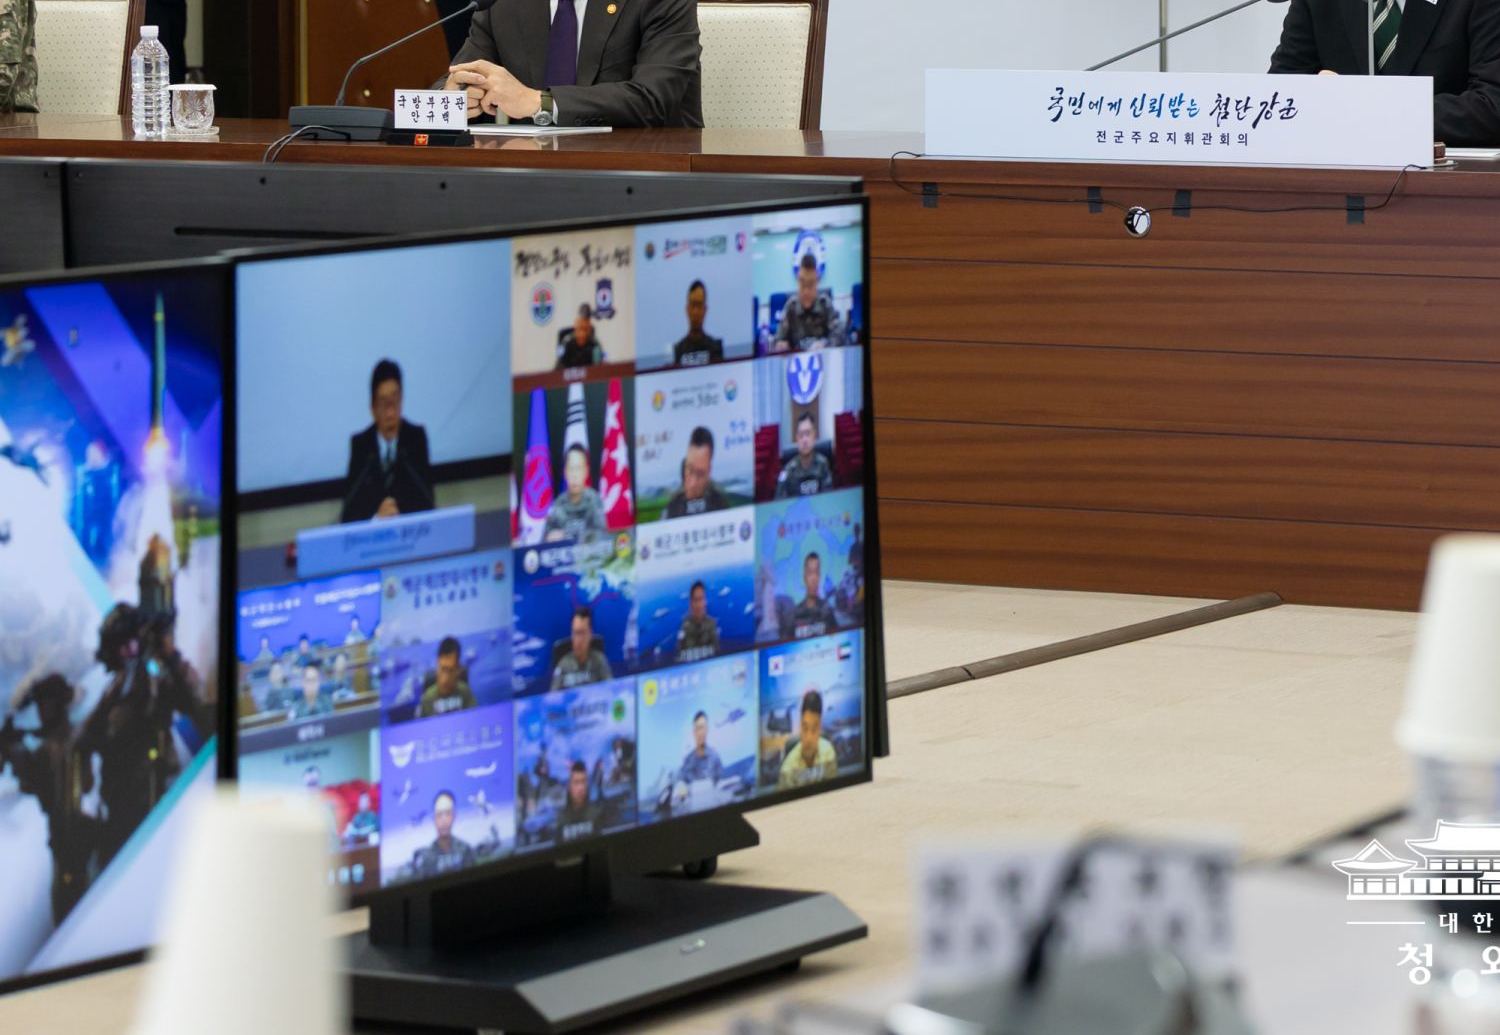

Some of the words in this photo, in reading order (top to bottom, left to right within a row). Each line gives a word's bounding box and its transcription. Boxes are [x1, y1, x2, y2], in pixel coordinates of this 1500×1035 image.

[397, 95, 465, 110] 국방부장관
[1048, 86, 1122, 122] 국민에게
[1130, 92, 1200, 118] 신뢰받는
[411, 110, 449, 124] 안규백
